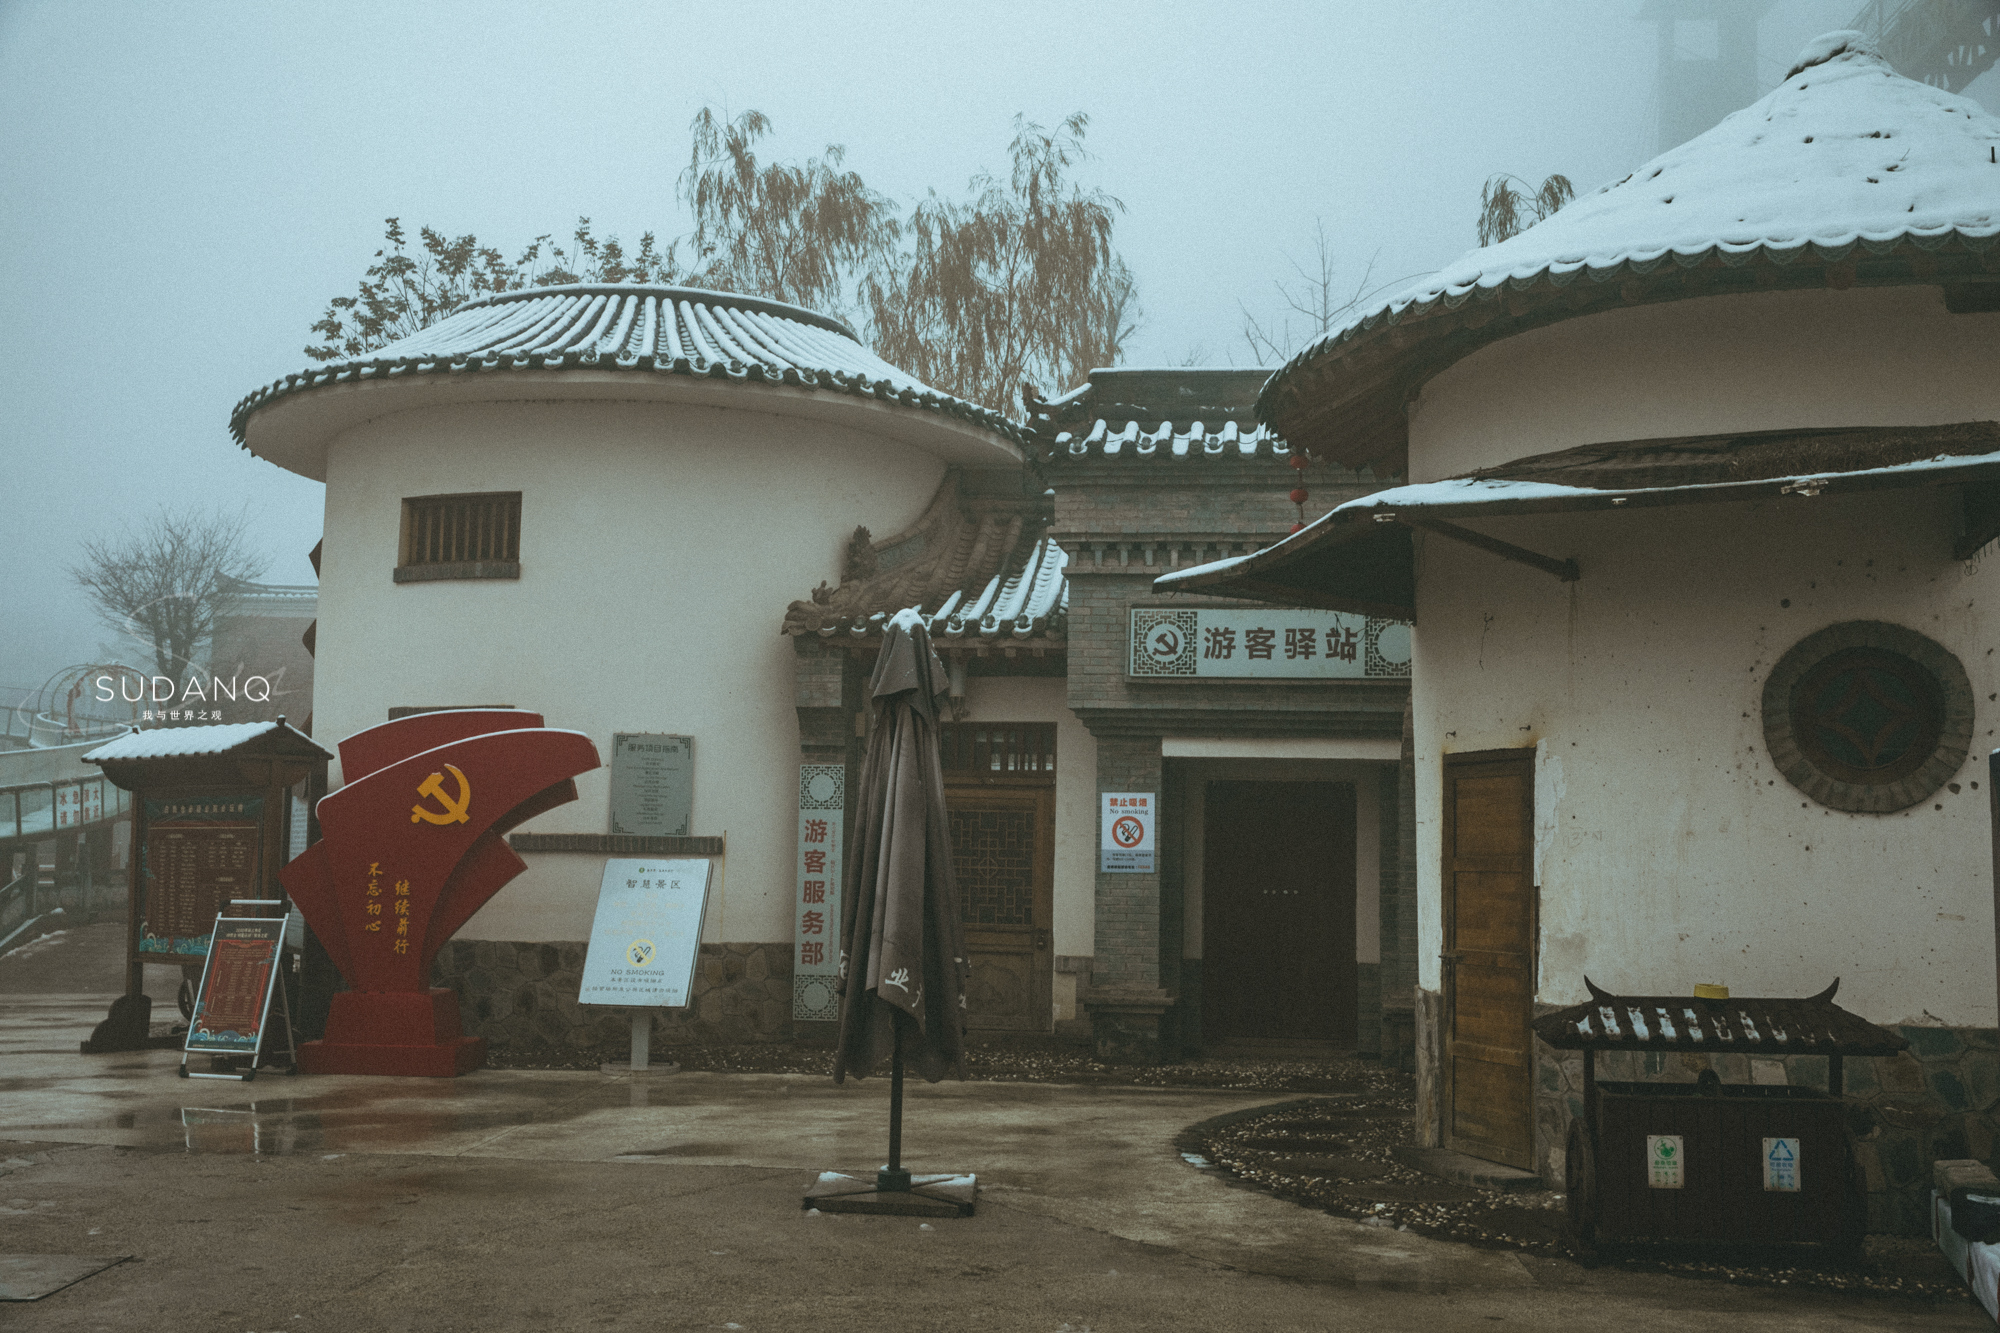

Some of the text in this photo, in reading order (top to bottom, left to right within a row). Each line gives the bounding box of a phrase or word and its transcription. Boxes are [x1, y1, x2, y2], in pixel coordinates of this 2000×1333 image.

[1203, 626, 1358, 662] 游客驿站
[627, 743, 679, 753] 服务项目指南
[1109, 798, 1148, 807] 禁止吸烟
[365, 862, 383, 932] 不忘初心
[625, 879, 681, 889] 智慧景区
[800, 819, 828, 967] 游客服务部
[394, 880, 410, 955] 继续前行
